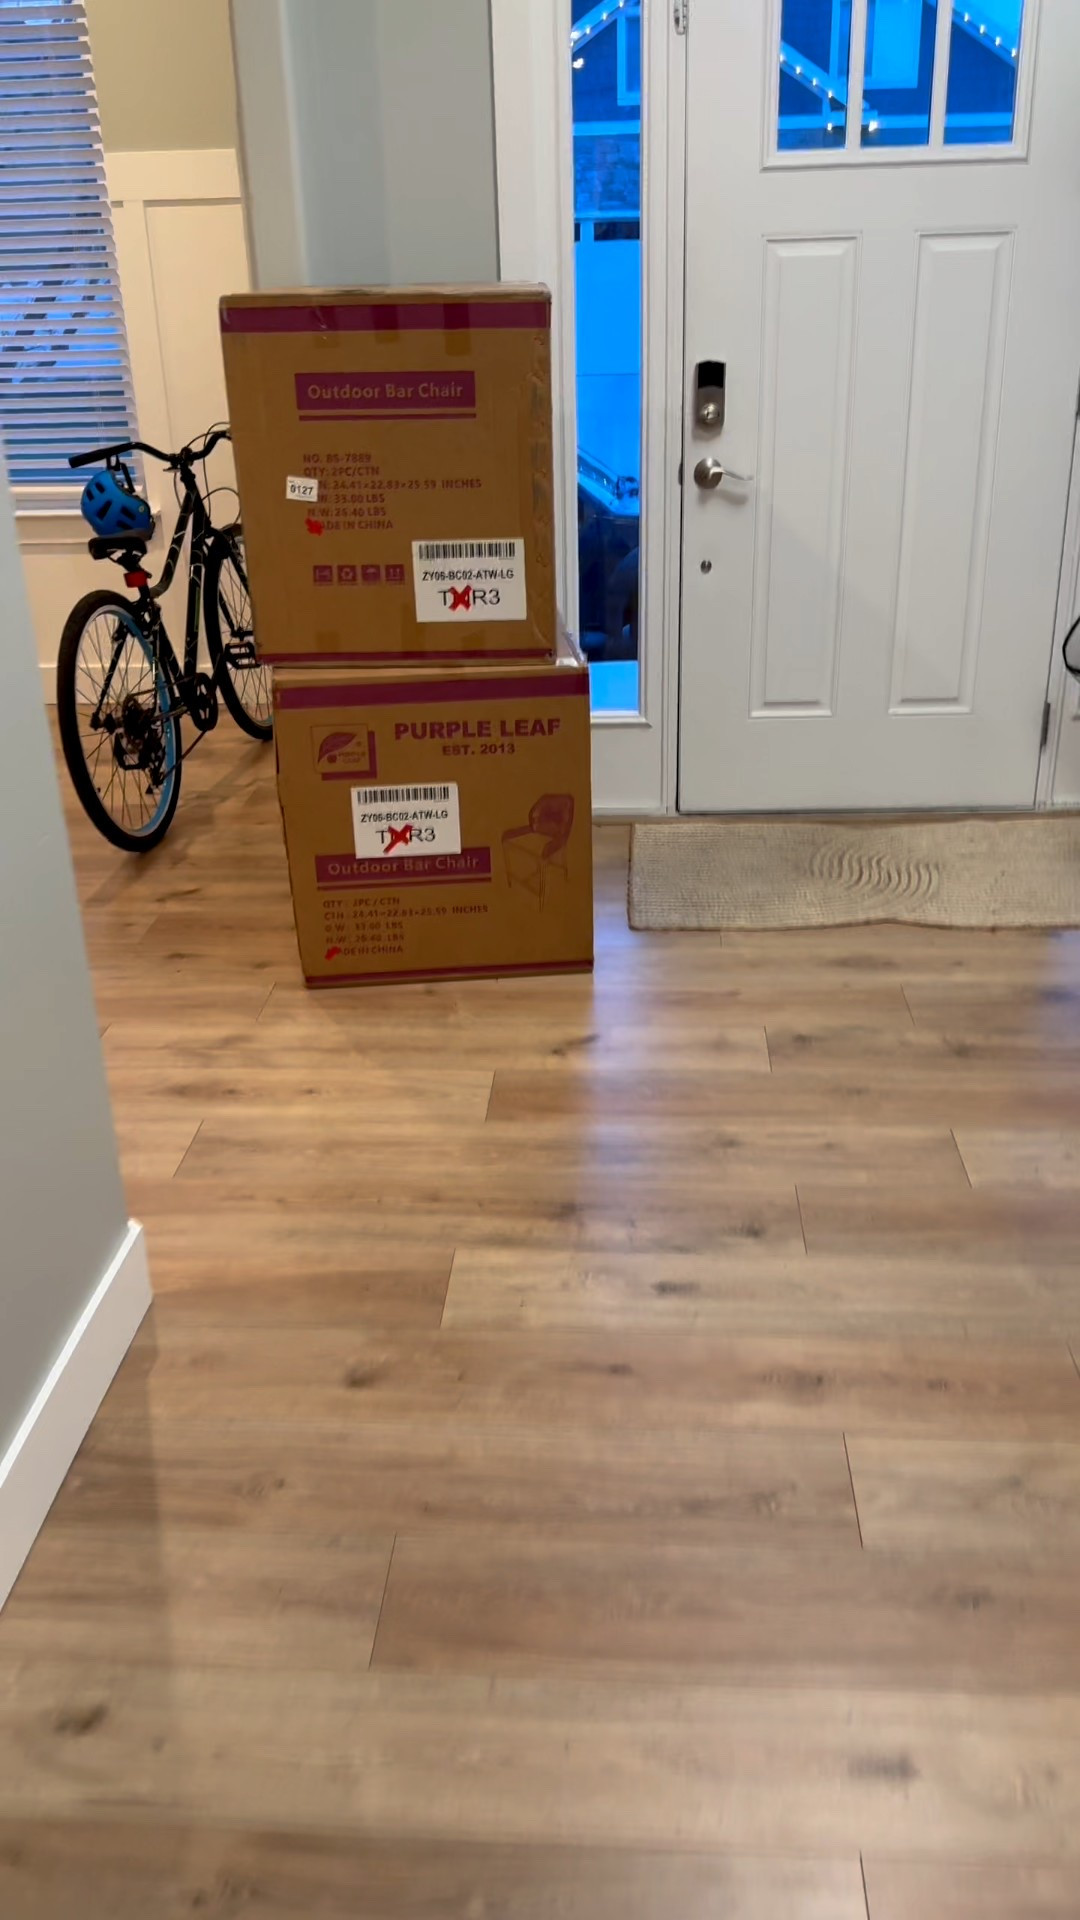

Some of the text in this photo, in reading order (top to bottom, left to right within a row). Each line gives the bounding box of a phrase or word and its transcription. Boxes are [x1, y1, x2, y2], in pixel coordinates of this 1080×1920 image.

[307, 382, 463, 399] Outdoor Bar Chair
[290, 484, 314, 496] 0127
[441, 479, 482, 489] INCHES
[366, 493, 385, 503] LBS
[368, 507, 387, 517] LBS
[343, 520, 356, 530] IN
[358, 520, 394, 530] CHINA
[437, 588, 501, 607] TR3
[394, 718, 561, 740] PURPLE LEAF
[442, 743, 515, 756] EST. 2013
[375, 827, 437, 845] TR3
[328, 856, 479, 876] Outdoor Bar Chair
[452, 905, 489, 915] INCHES
